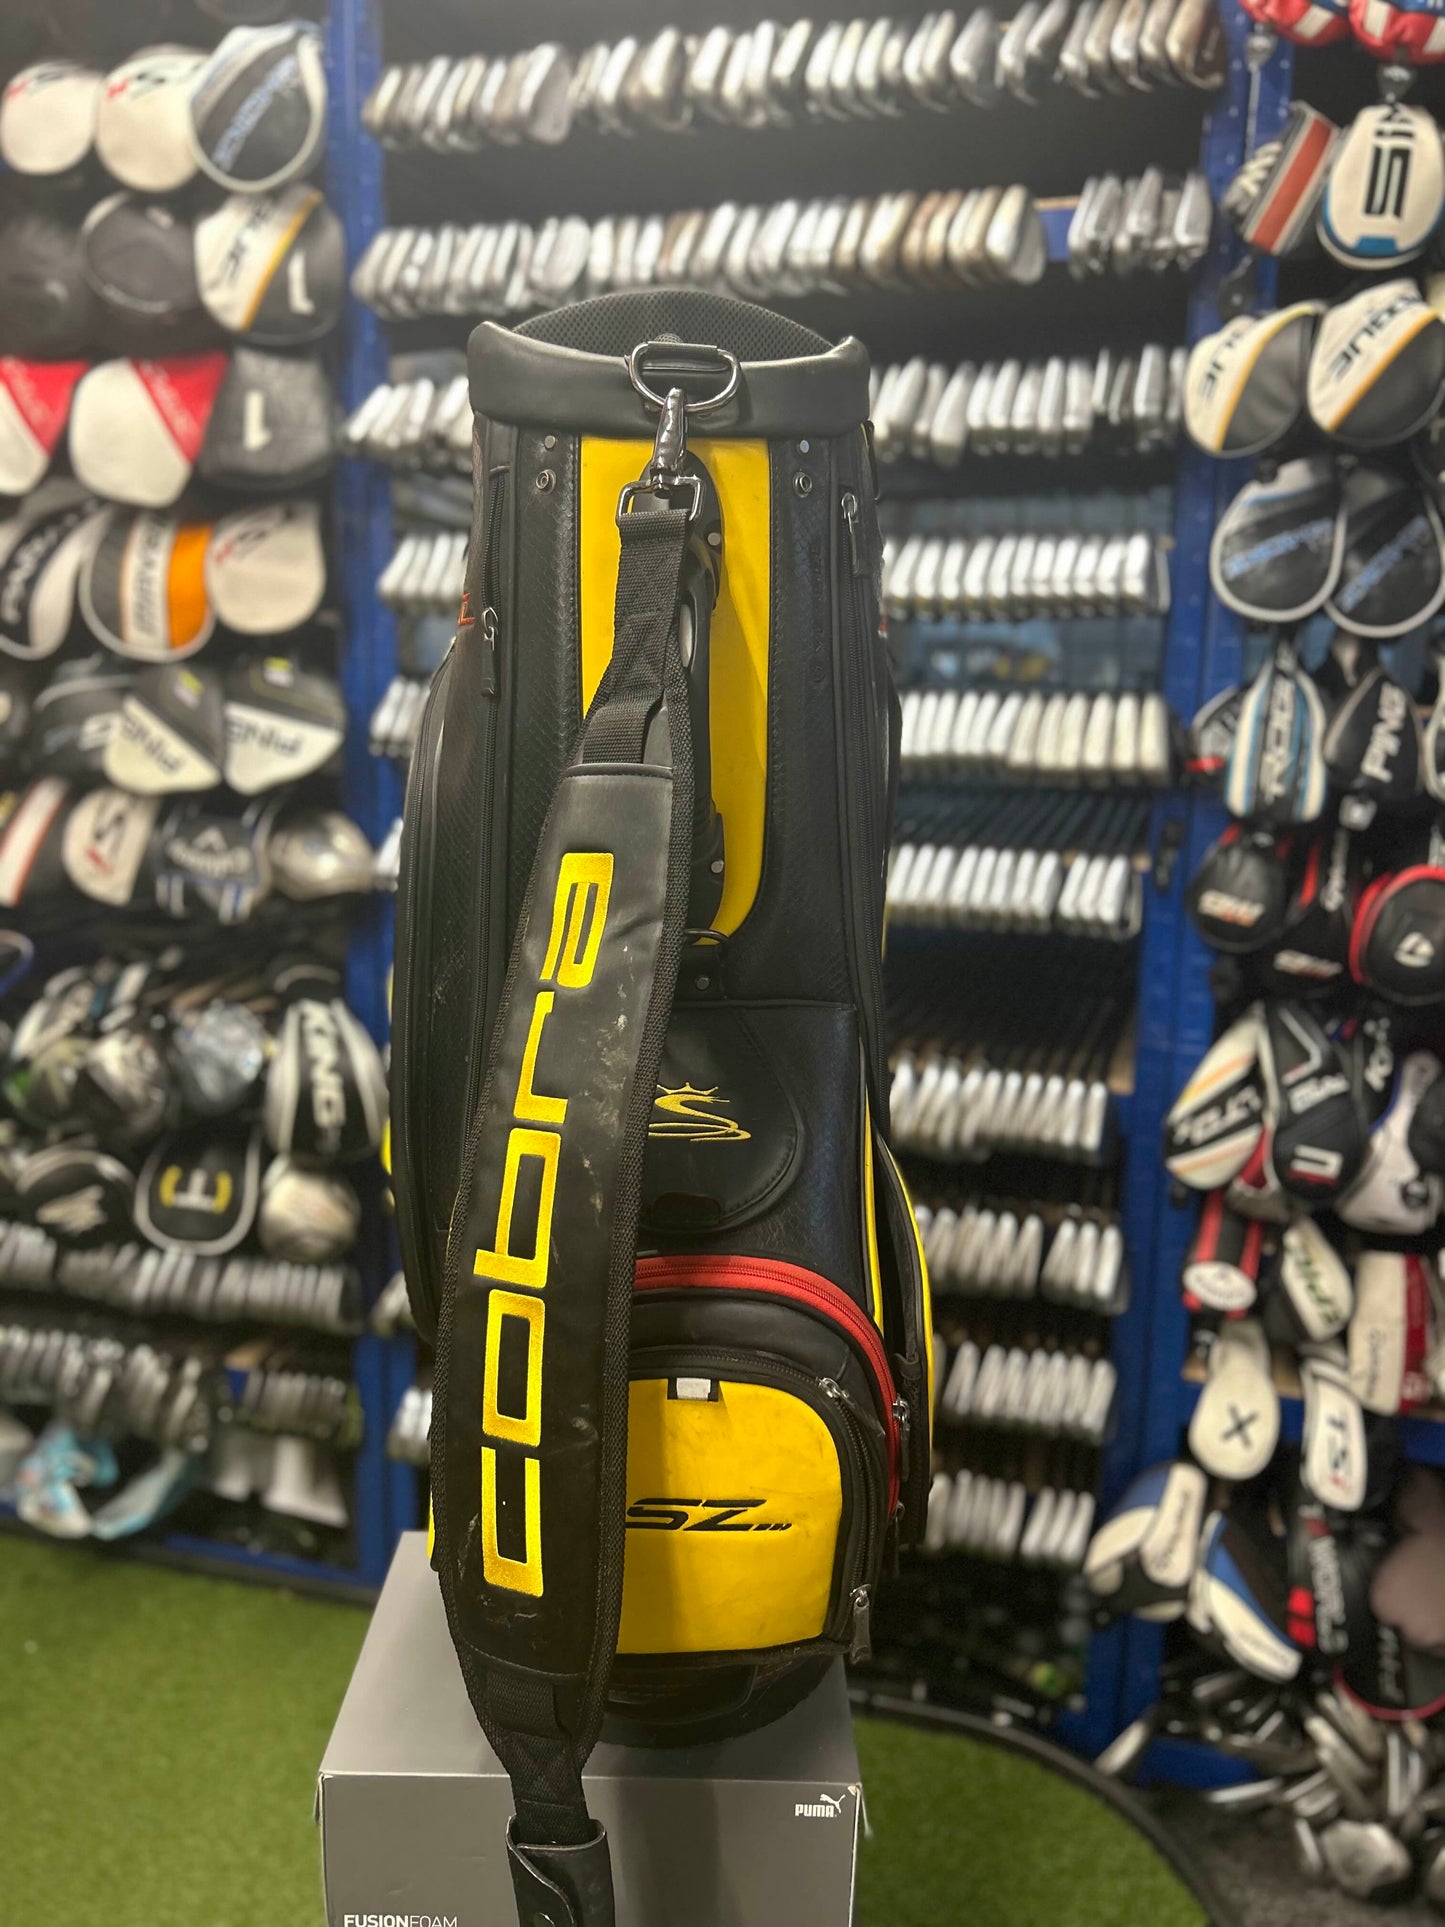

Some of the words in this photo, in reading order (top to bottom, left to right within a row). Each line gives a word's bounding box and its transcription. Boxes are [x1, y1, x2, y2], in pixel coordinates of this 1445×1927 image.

[122, 716, 185, 775] PING
[226, 718, 303, 757] PING
[1360, 682, 1407, 782] PING
[473, 852, 614, 1598] cobra
[795, 1803, 835, 1817] PUMA
[343, 1914, 457, 1927] FUSIONFOAM
